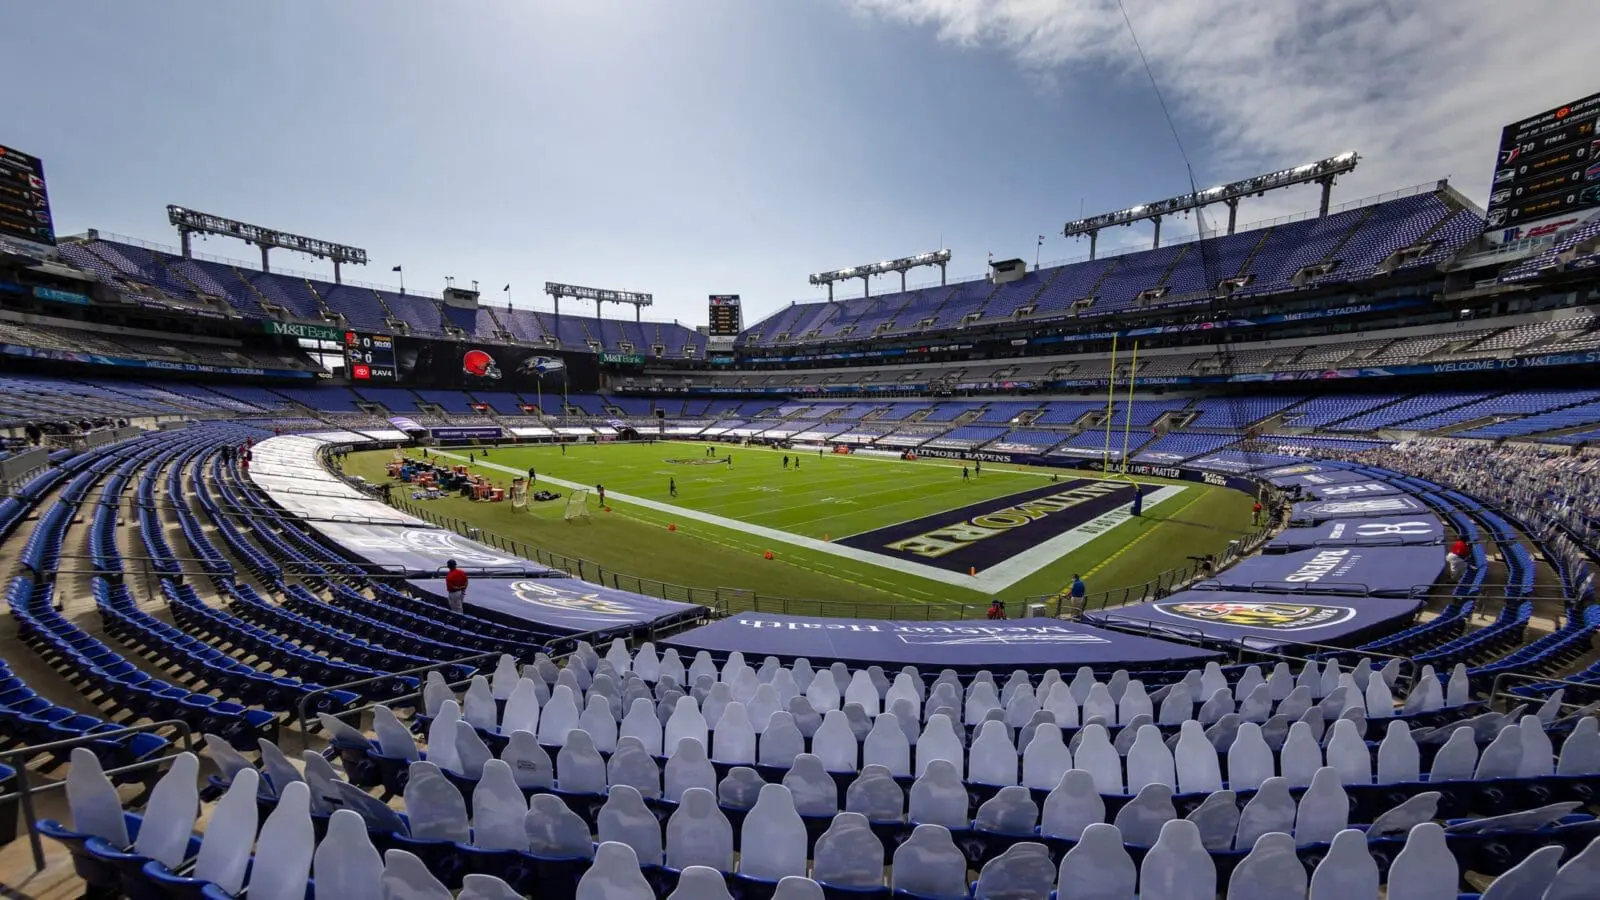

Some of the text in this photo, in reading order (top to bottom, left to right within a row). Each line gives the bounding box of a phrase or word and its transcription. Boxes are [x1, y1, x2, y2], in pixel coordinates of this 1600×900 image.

[1544, 133, 1567, 145] FINAL
[1503, 271, 1539, 281] RAVENS
[1326, 304, 1371, 316] STADIUM
[272, 321, 339, 340] M&T Bank
[363, 337, 371, 348] 0
[365, 353, 373, 364] 0
[1433, 360, 1495, 373] WELCOME
[1500, 358, 1518, 369] TO
[1523, 356, 1550, 367] M&T
[145, 360, 183, 371] WELCOME
[185, 364, 197, 372] TO
[230, 367, 265, 376] STADIUM
[371, 369, 392, 377] RAV4
[1143, 377, 1178, 385] STADIUM
[907, 447, 1012, 463] ALTIMORE RAVENS
[1151, 466, 1181, 479] MATTER
[883, 480, 1134, 558] BALTIMORE
[1285, 549, 1350, 583] RAVENS
[738, 618, 883, 633] Health
